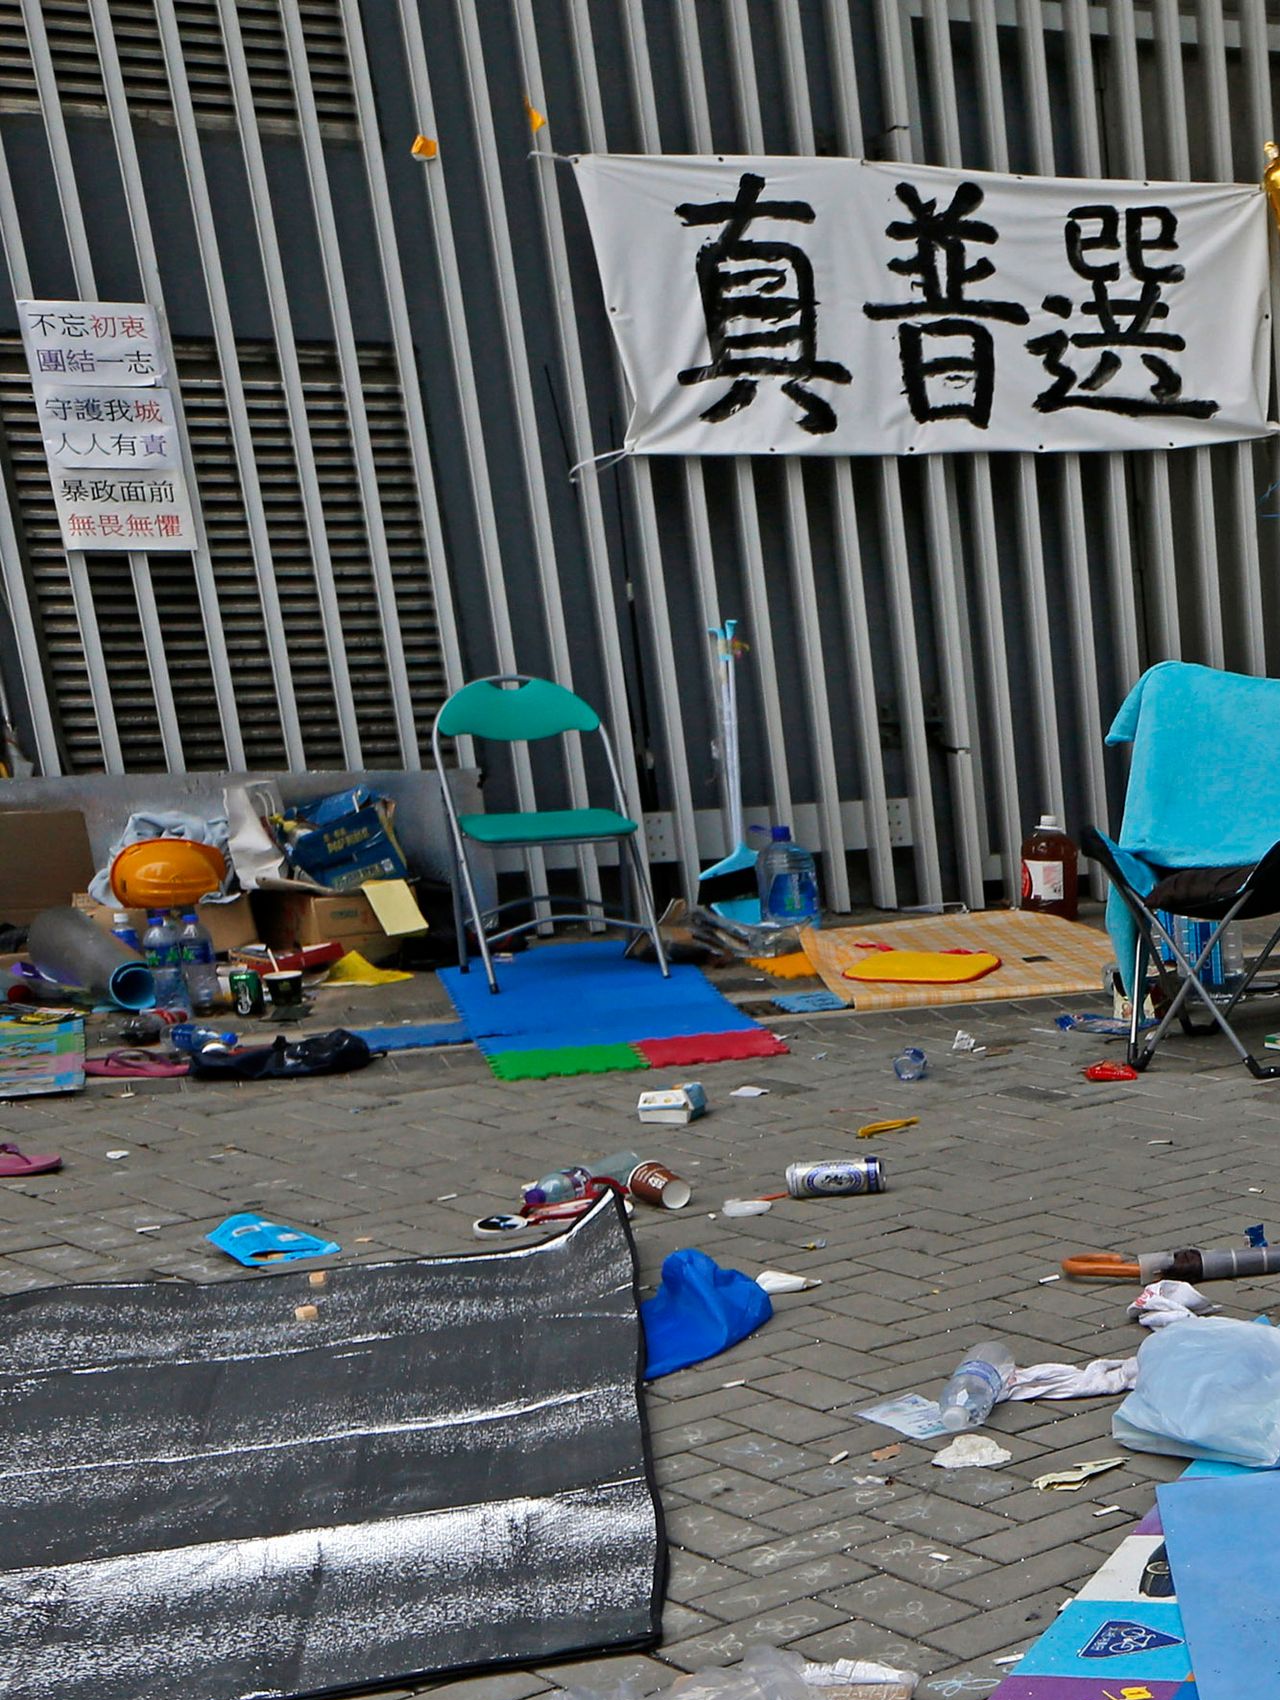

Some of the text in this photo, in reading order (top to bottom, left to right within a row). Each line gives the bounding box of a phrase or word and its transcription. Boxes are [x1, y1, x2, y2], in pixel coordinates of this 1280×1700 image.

[674, 172, 1219, 435] 真普選
[28, 313, 148, 339] 不忘初衷
[36, 350, 156, 374] 團結一志
[45, 399, 164, 423] 守護我城
[55, 433, 168, 457] 人人有責
[62, 479, 175, 504] 暴政面前
[68, 513, 183, 537] 無畏無懼
